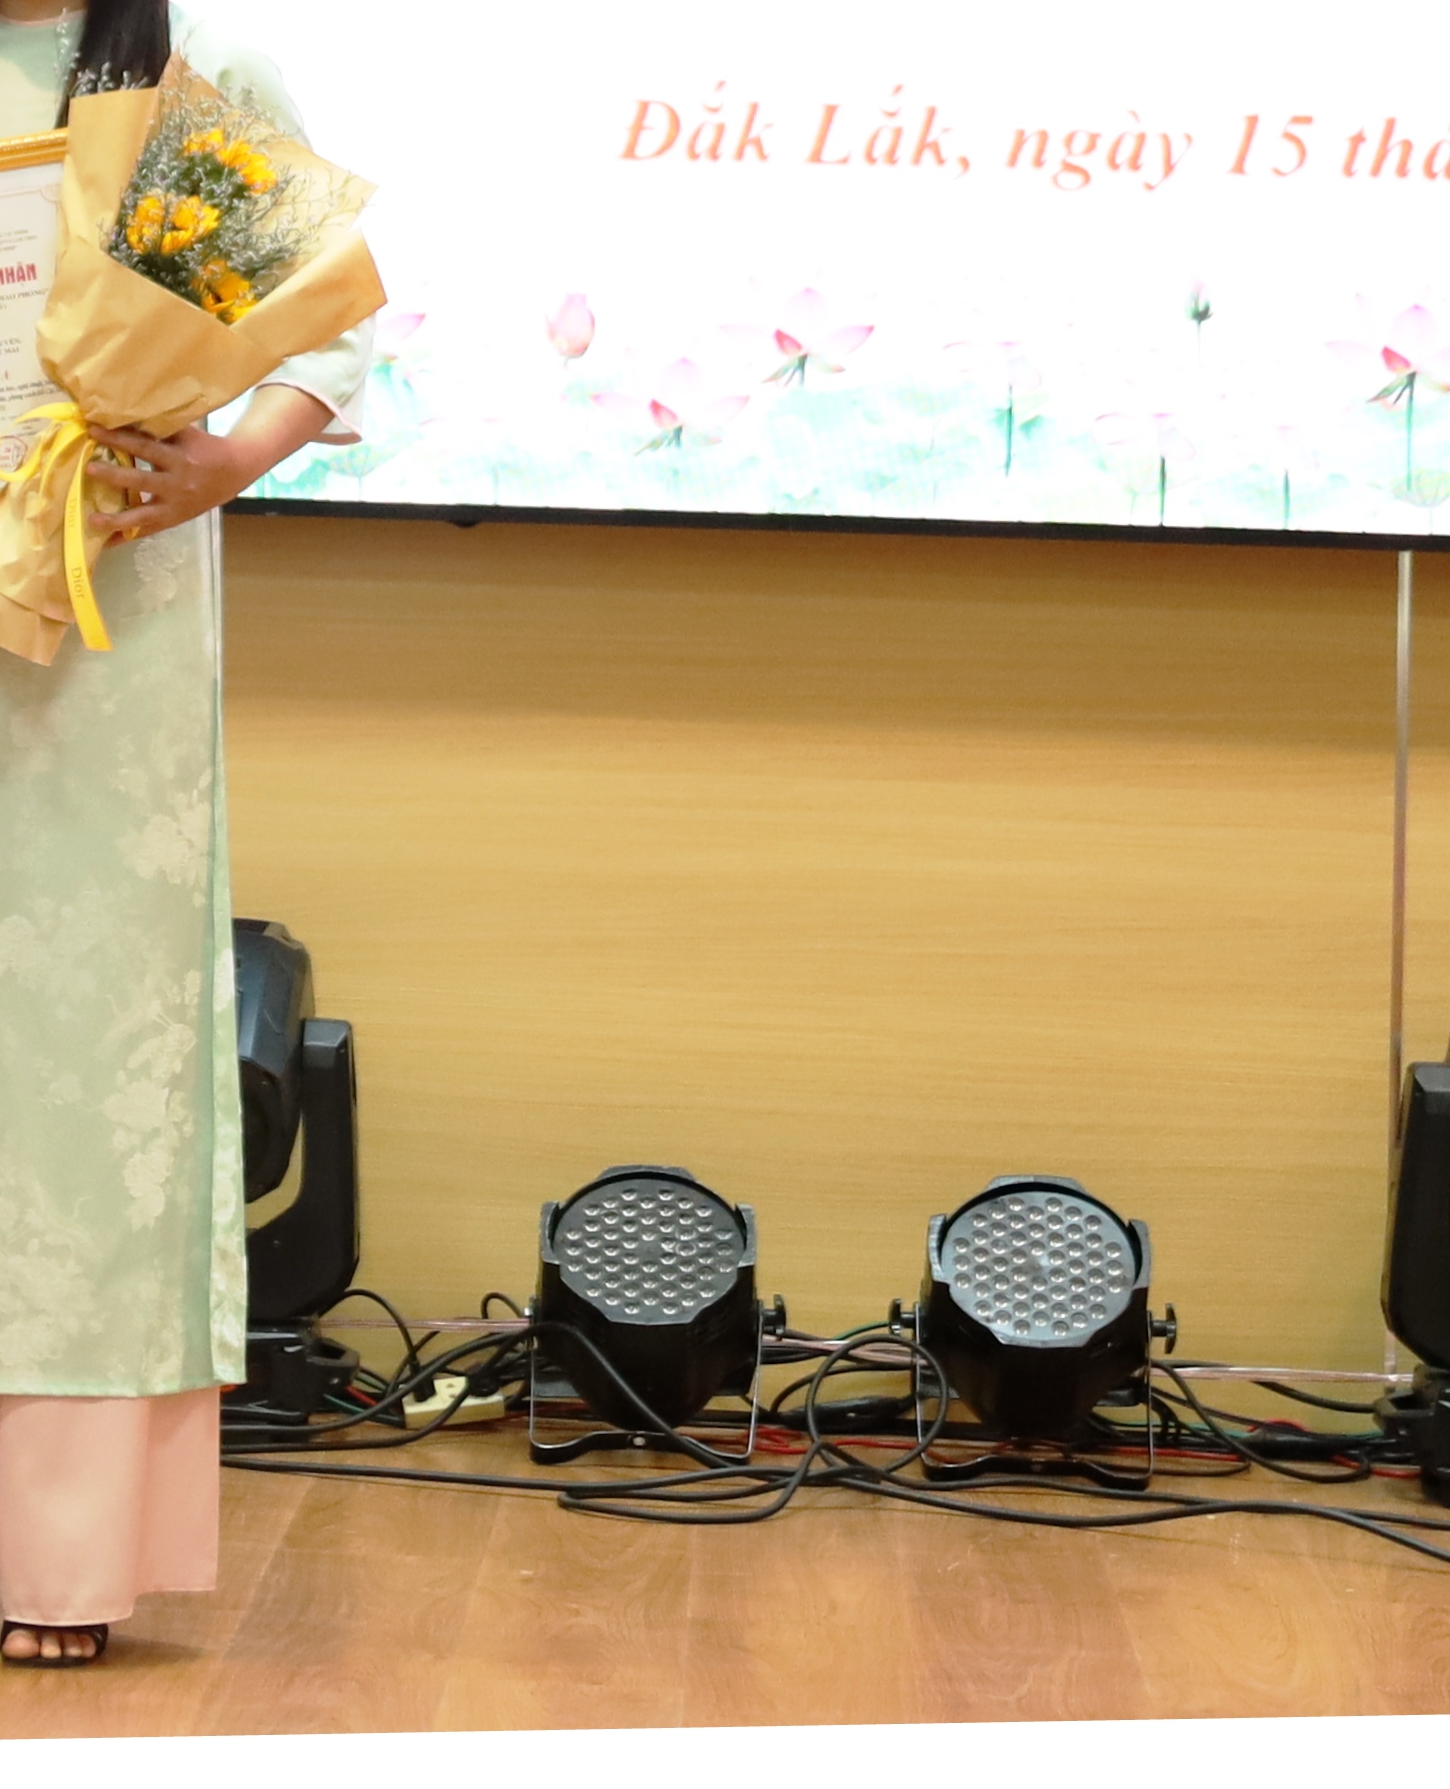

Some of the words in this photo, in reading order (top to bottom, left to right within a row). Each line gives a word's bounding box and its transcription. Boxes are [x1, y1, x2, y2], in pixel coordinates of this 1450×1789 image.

[621, 100, 768, 161] Đắk
[807, 85, 970, 172] Lắk,
[1007, 112, 1192, 191] ngày
[1230, 115, 1313, 176] 15
[71, 566, 85, 599] Dior
